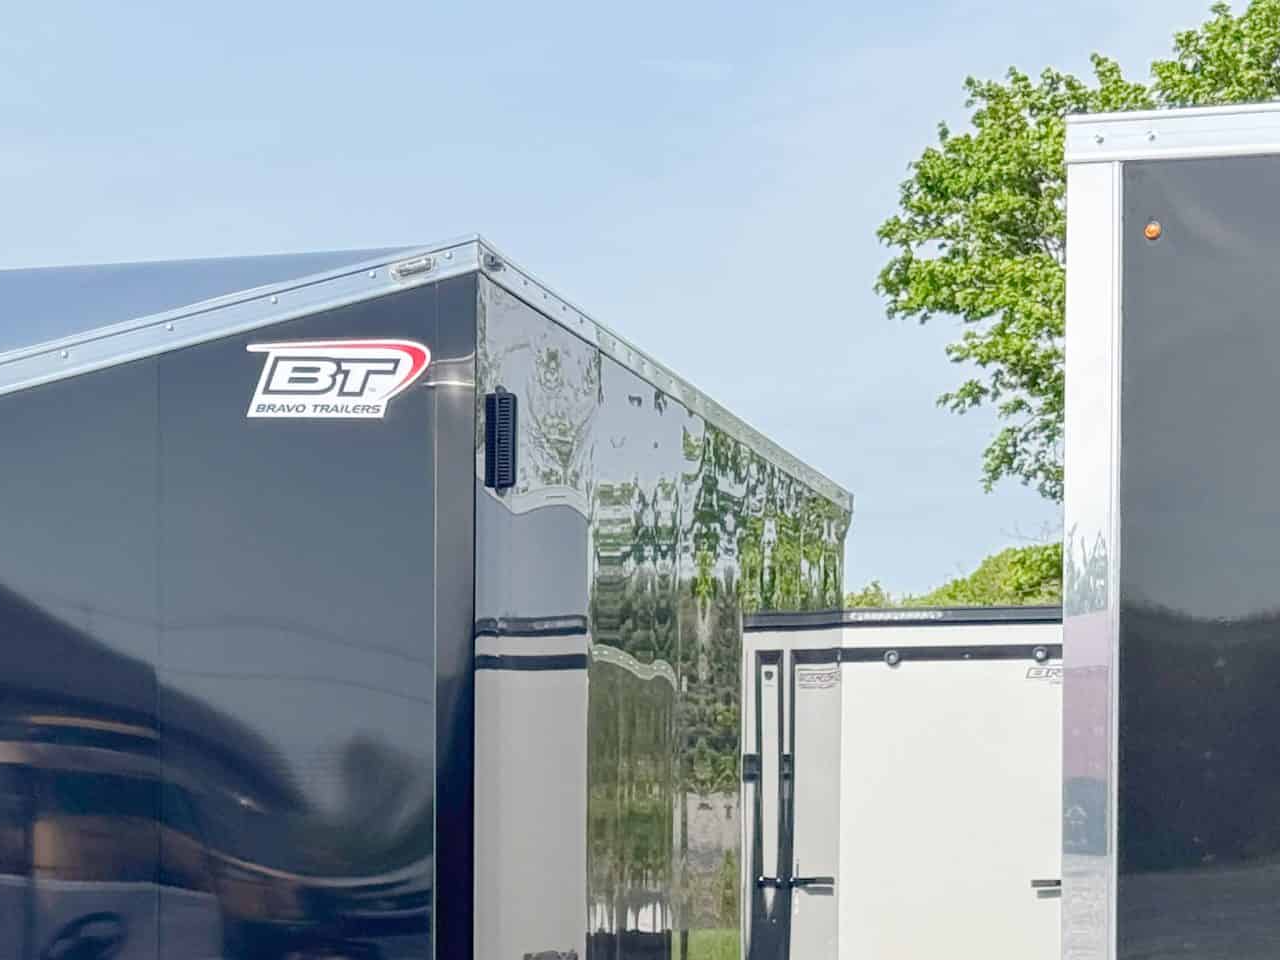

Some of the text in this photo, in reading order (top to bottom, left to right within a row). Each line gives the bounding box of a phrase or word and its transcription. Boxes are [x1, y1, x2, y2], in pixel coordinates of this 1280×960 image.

[263, 356, 401, 397] BT
[255, 403, 382, 415] BRAVO TRAILERS
